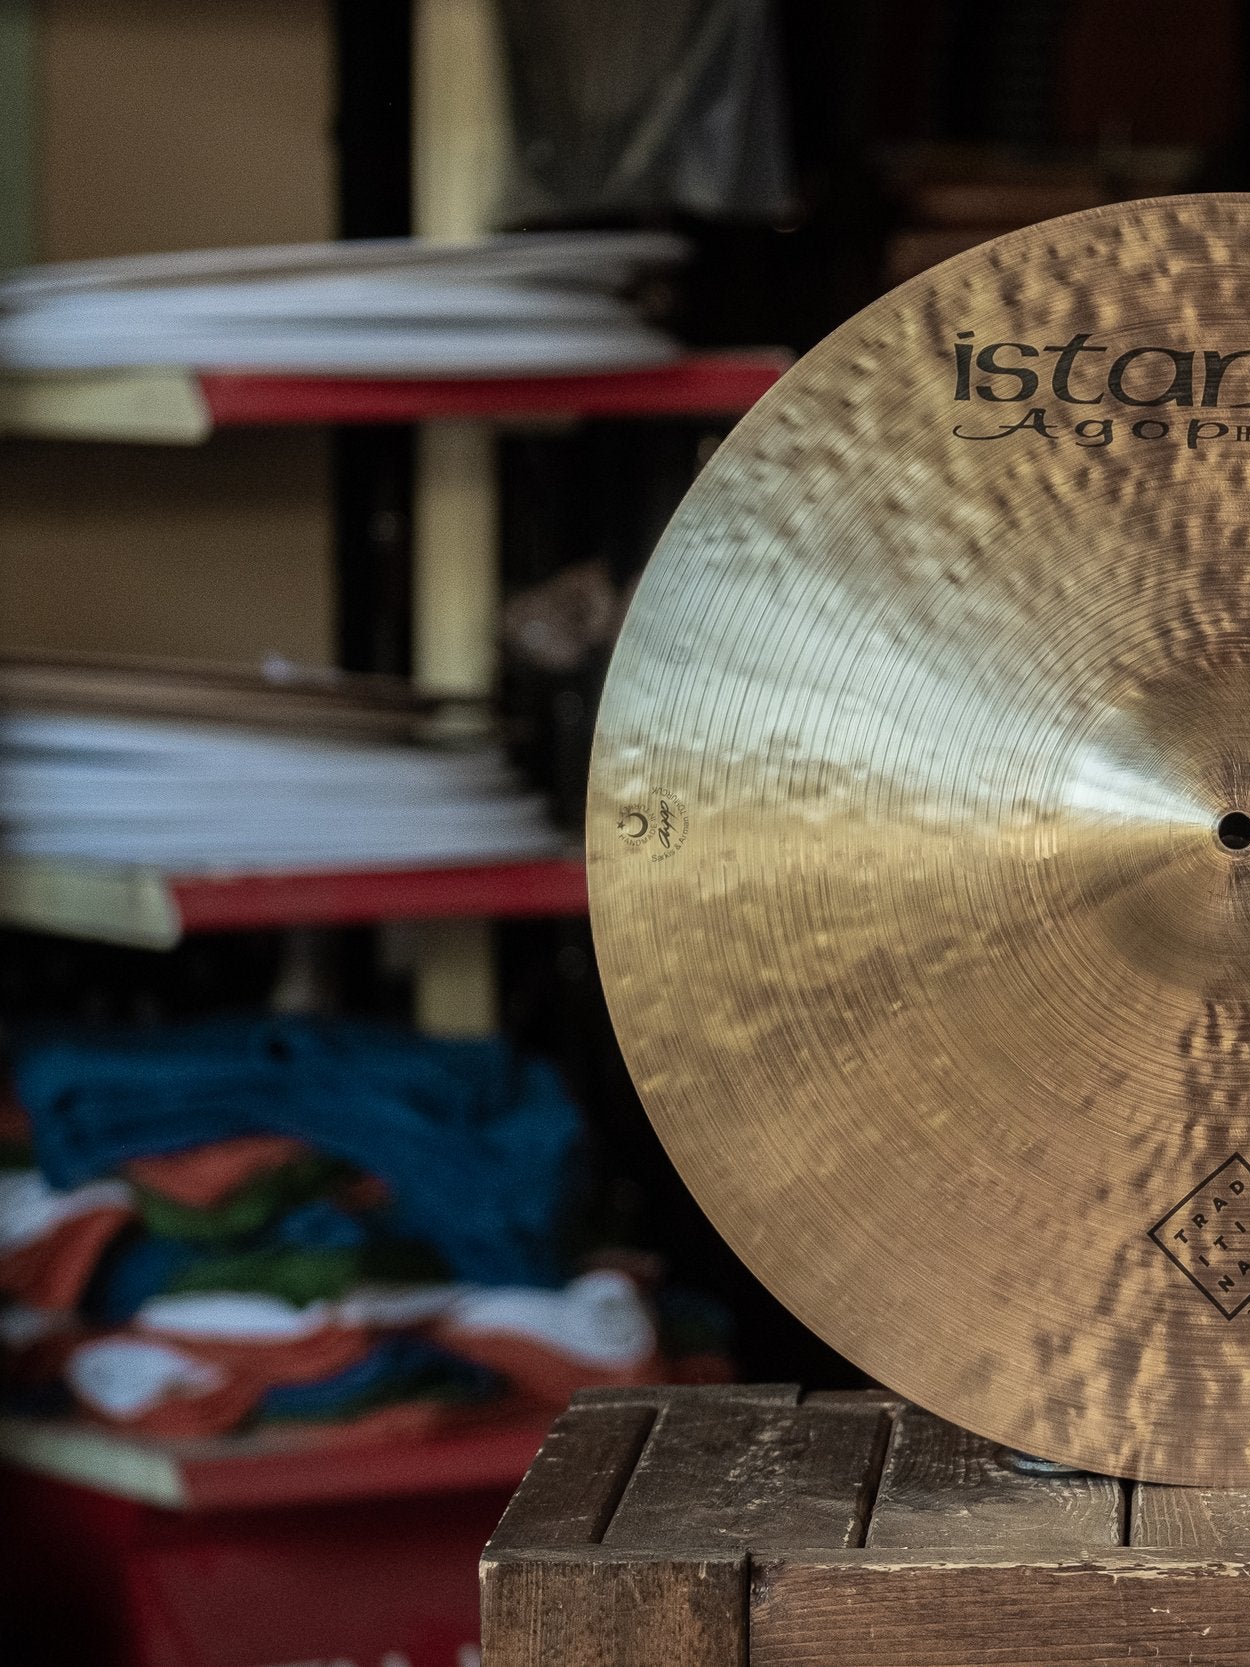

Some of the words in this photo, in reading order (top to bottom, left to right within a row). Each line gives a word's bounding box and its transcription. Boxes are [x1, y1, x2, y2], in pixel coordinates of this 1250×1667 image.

[952, 408, 1230, 450] Agop
[679, 816, 690, 844] Arman
[1173, 1180, 1245, 1244] TRAD
